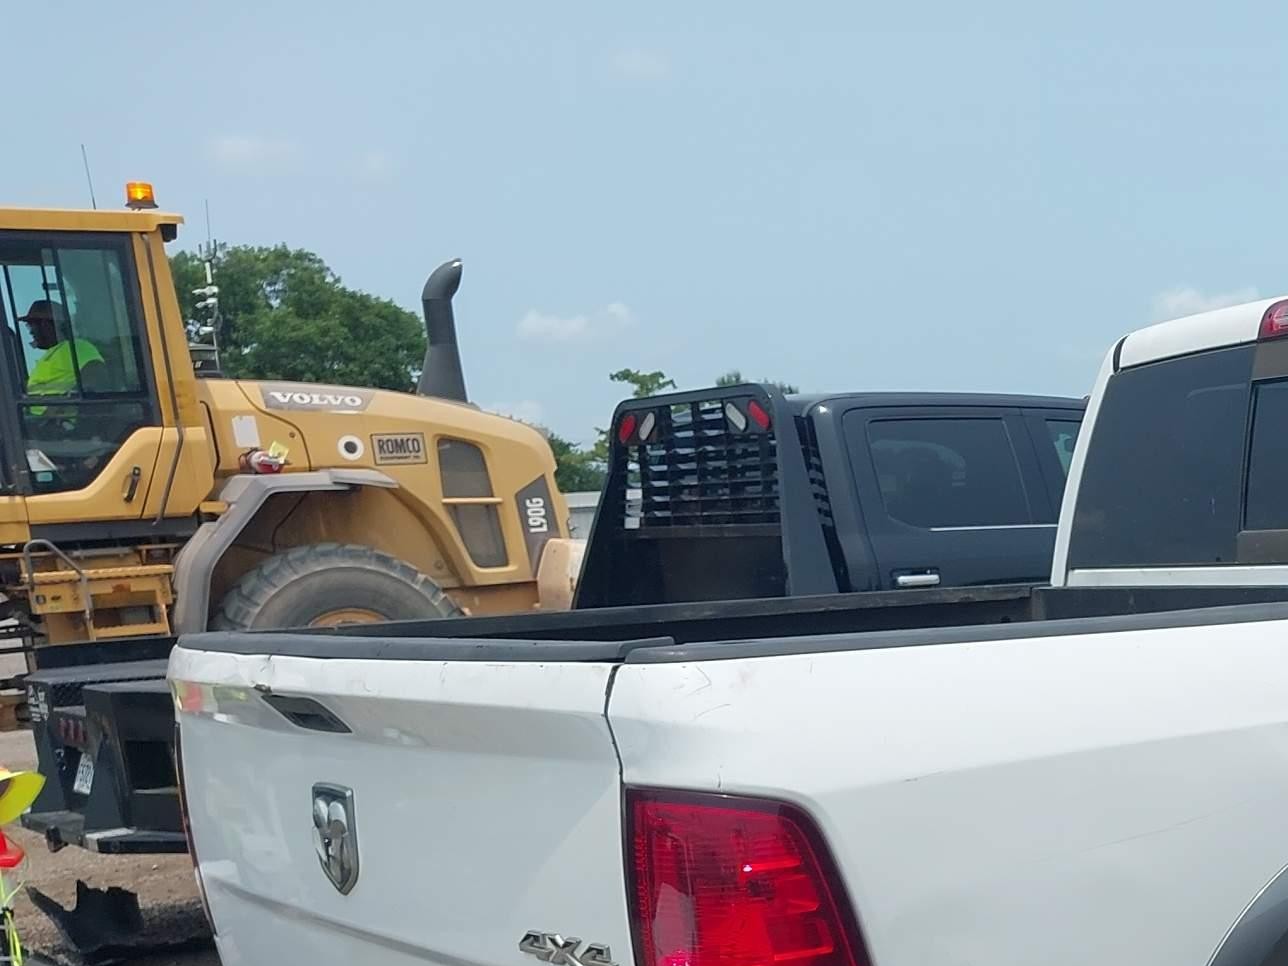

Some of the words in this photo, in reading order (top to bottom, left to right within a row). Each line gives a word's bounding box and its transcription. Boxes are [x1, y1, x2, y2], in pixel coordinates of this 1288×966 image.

[269, 391, 363, 407] VOLVO
[377, 438, 421, 455] ROMCO
[525, 497, 548, 533] L90G
